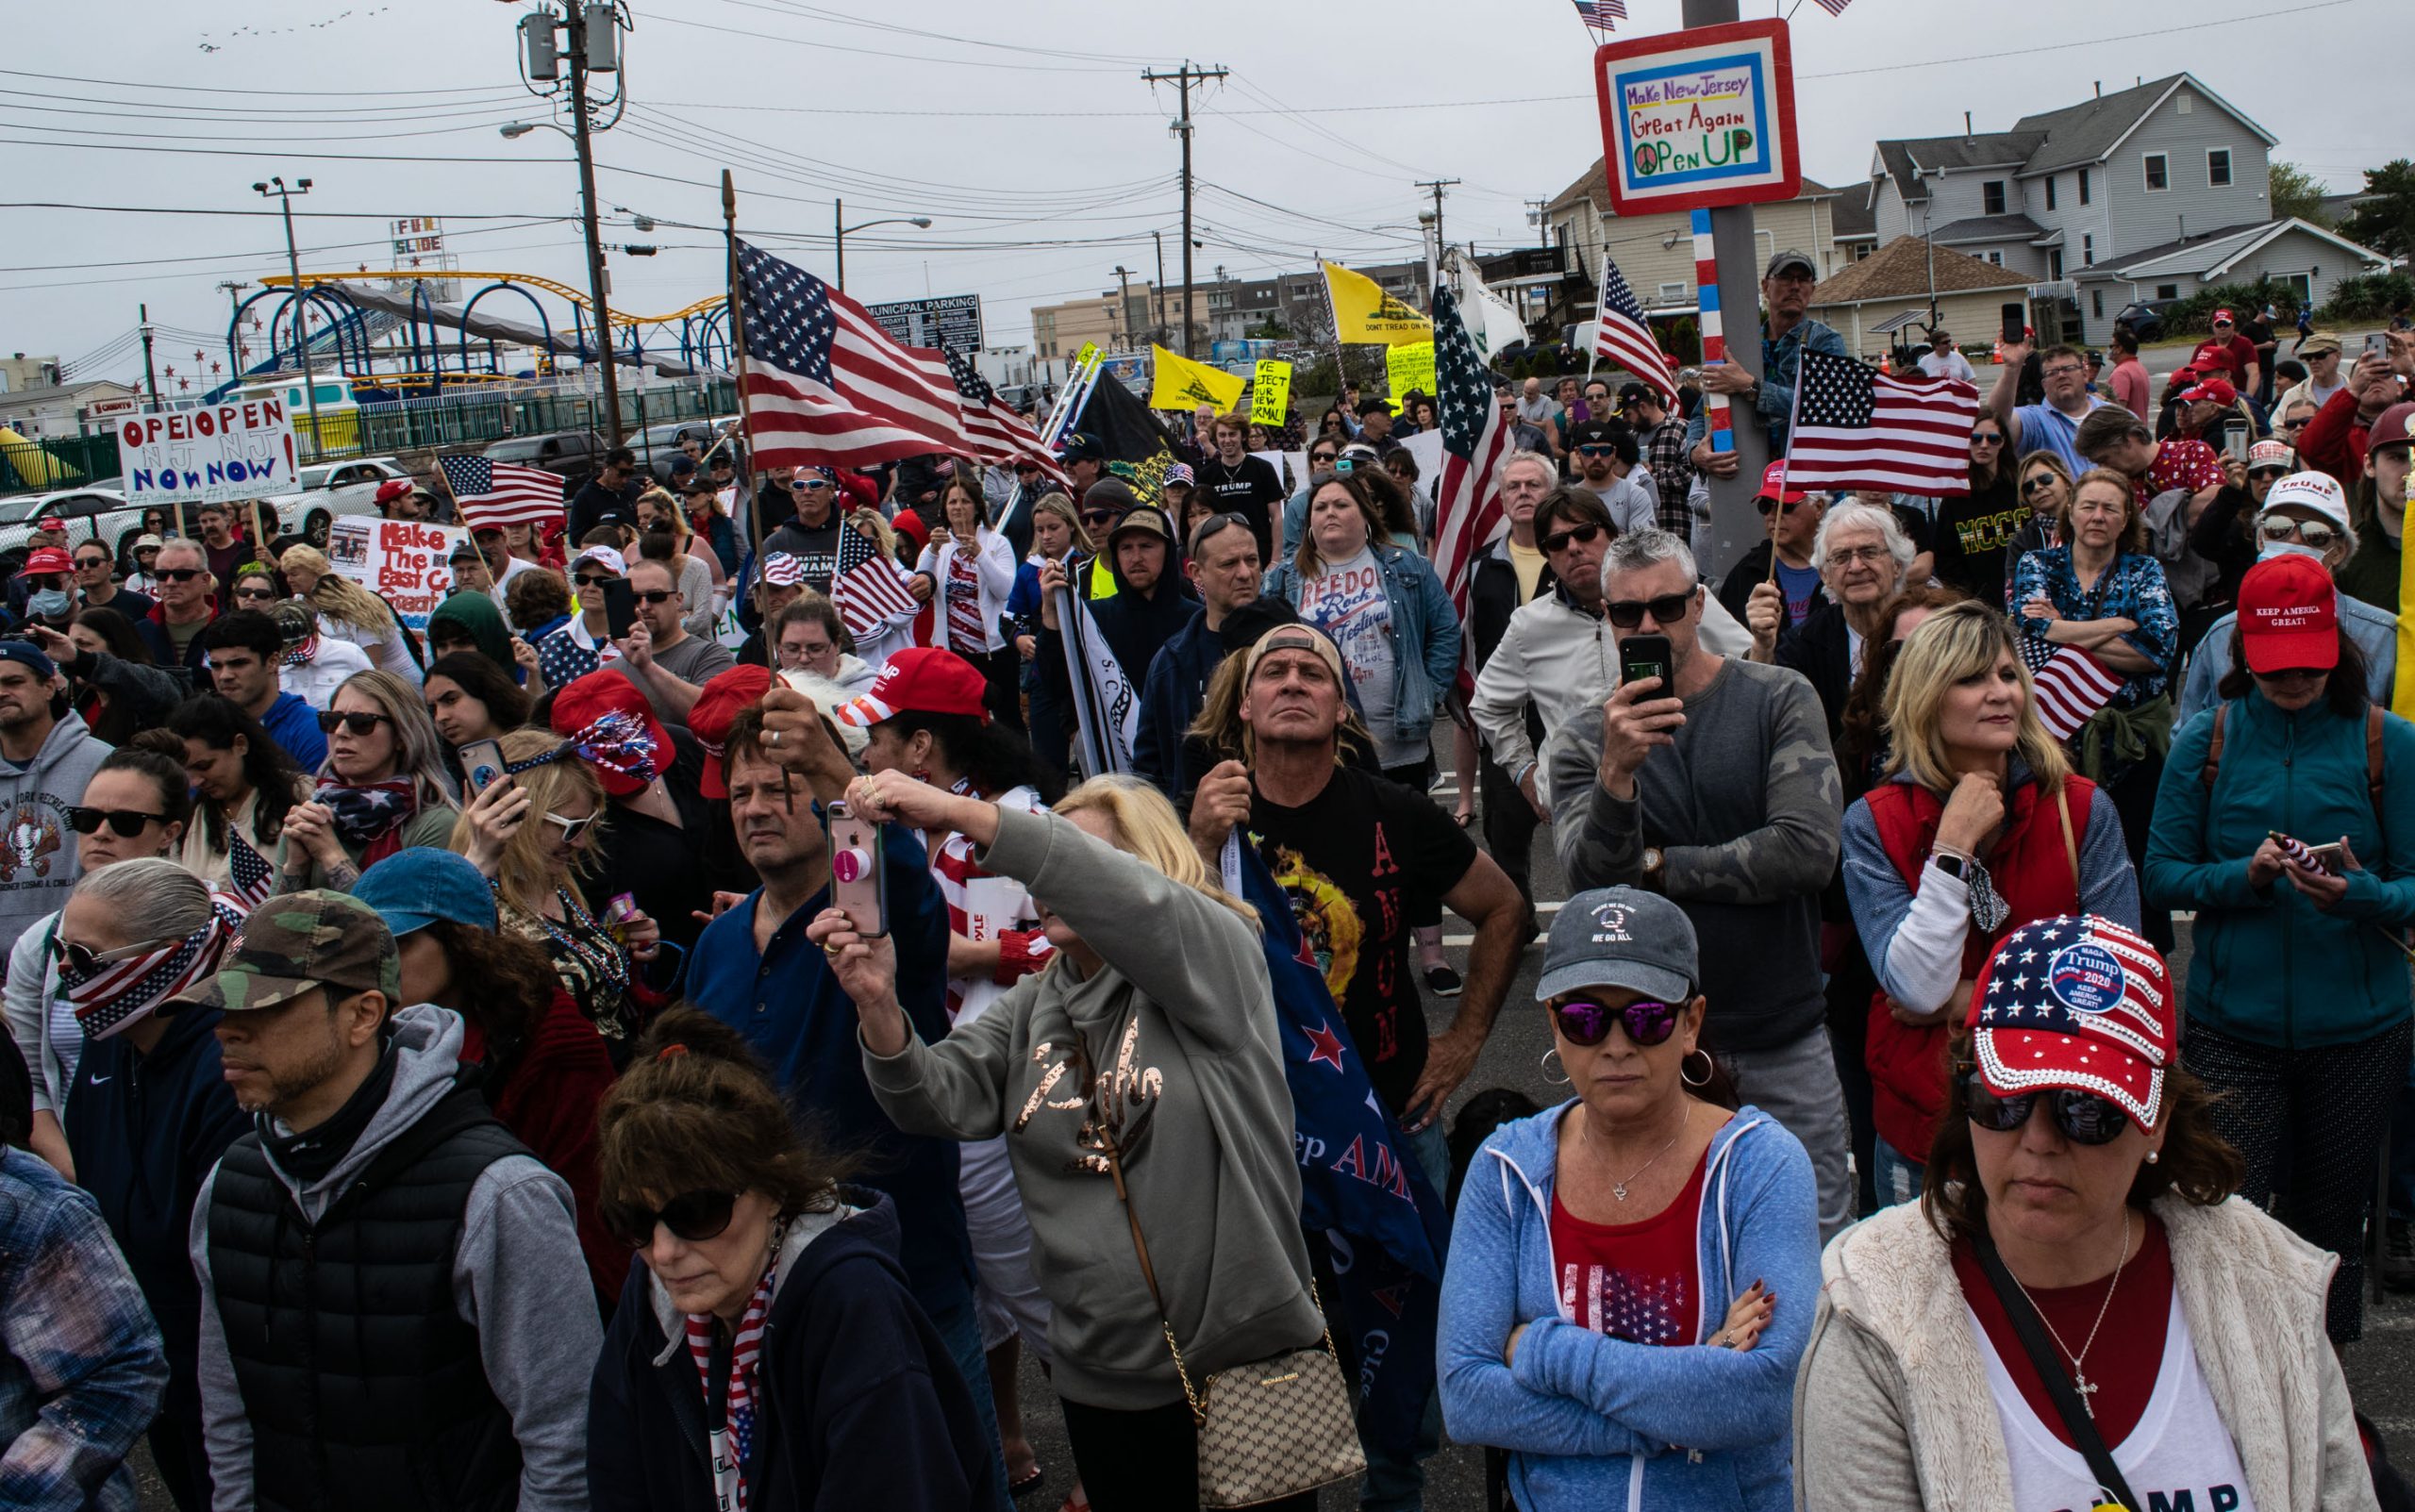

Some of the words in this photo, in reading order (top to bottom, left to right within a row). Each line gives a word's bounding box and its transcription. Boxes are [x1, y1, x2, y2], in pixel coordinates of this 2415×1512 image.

[1626, 85, 1660, 107] Make
[1663, 80, 1699, 101] New
[1700, 75, 1750, 97] Jersey
[1630, 110, 1683, 139] Great
[1688, 103, 1744, 134] Again
[1703, 128, 1754, 166] UP
[395, 236, 441, 255] SLIDE
[866, 302, 924, 317] MUNICIPAL
[926, 296, 975, 310] PARKING
[1423, 322, 1432, 330] ME
[1259, 361, 1274, 373] WE
[1257, 374, 1287, 387] EJECT
[1255, 387, 1273, 396] OUR
[195, 400, 284, 436] OPEN
[207, 457, 276, 485] NOW
[1214, 482, 1252, 492] TRUMP
[2282, 480, 2332, 495] TRUMP
[380, 522, 446, 551] Make
[381, 545, 428, 570] The
[378, 566, 423, 590] East
[2256, 607, 2280, 616] KEEP
[2283, 606, 2321, 616] AMERICA
[1331, 606, 1390, 648] Festival
[2271, 617, 2307, 626] GREAT!
[1591, 934, 1604, 942] WE
[1617, 932, 1633, 941] ALL
[2081, 947, 2105, 957] MAGA
[2065, 951, 2120, 977] Trump
[2084, 972, 2111, 988] 2020
[2069, 989, 2103, 1003] AMERICA
[2076, 984, 2097, 993] KEEP
